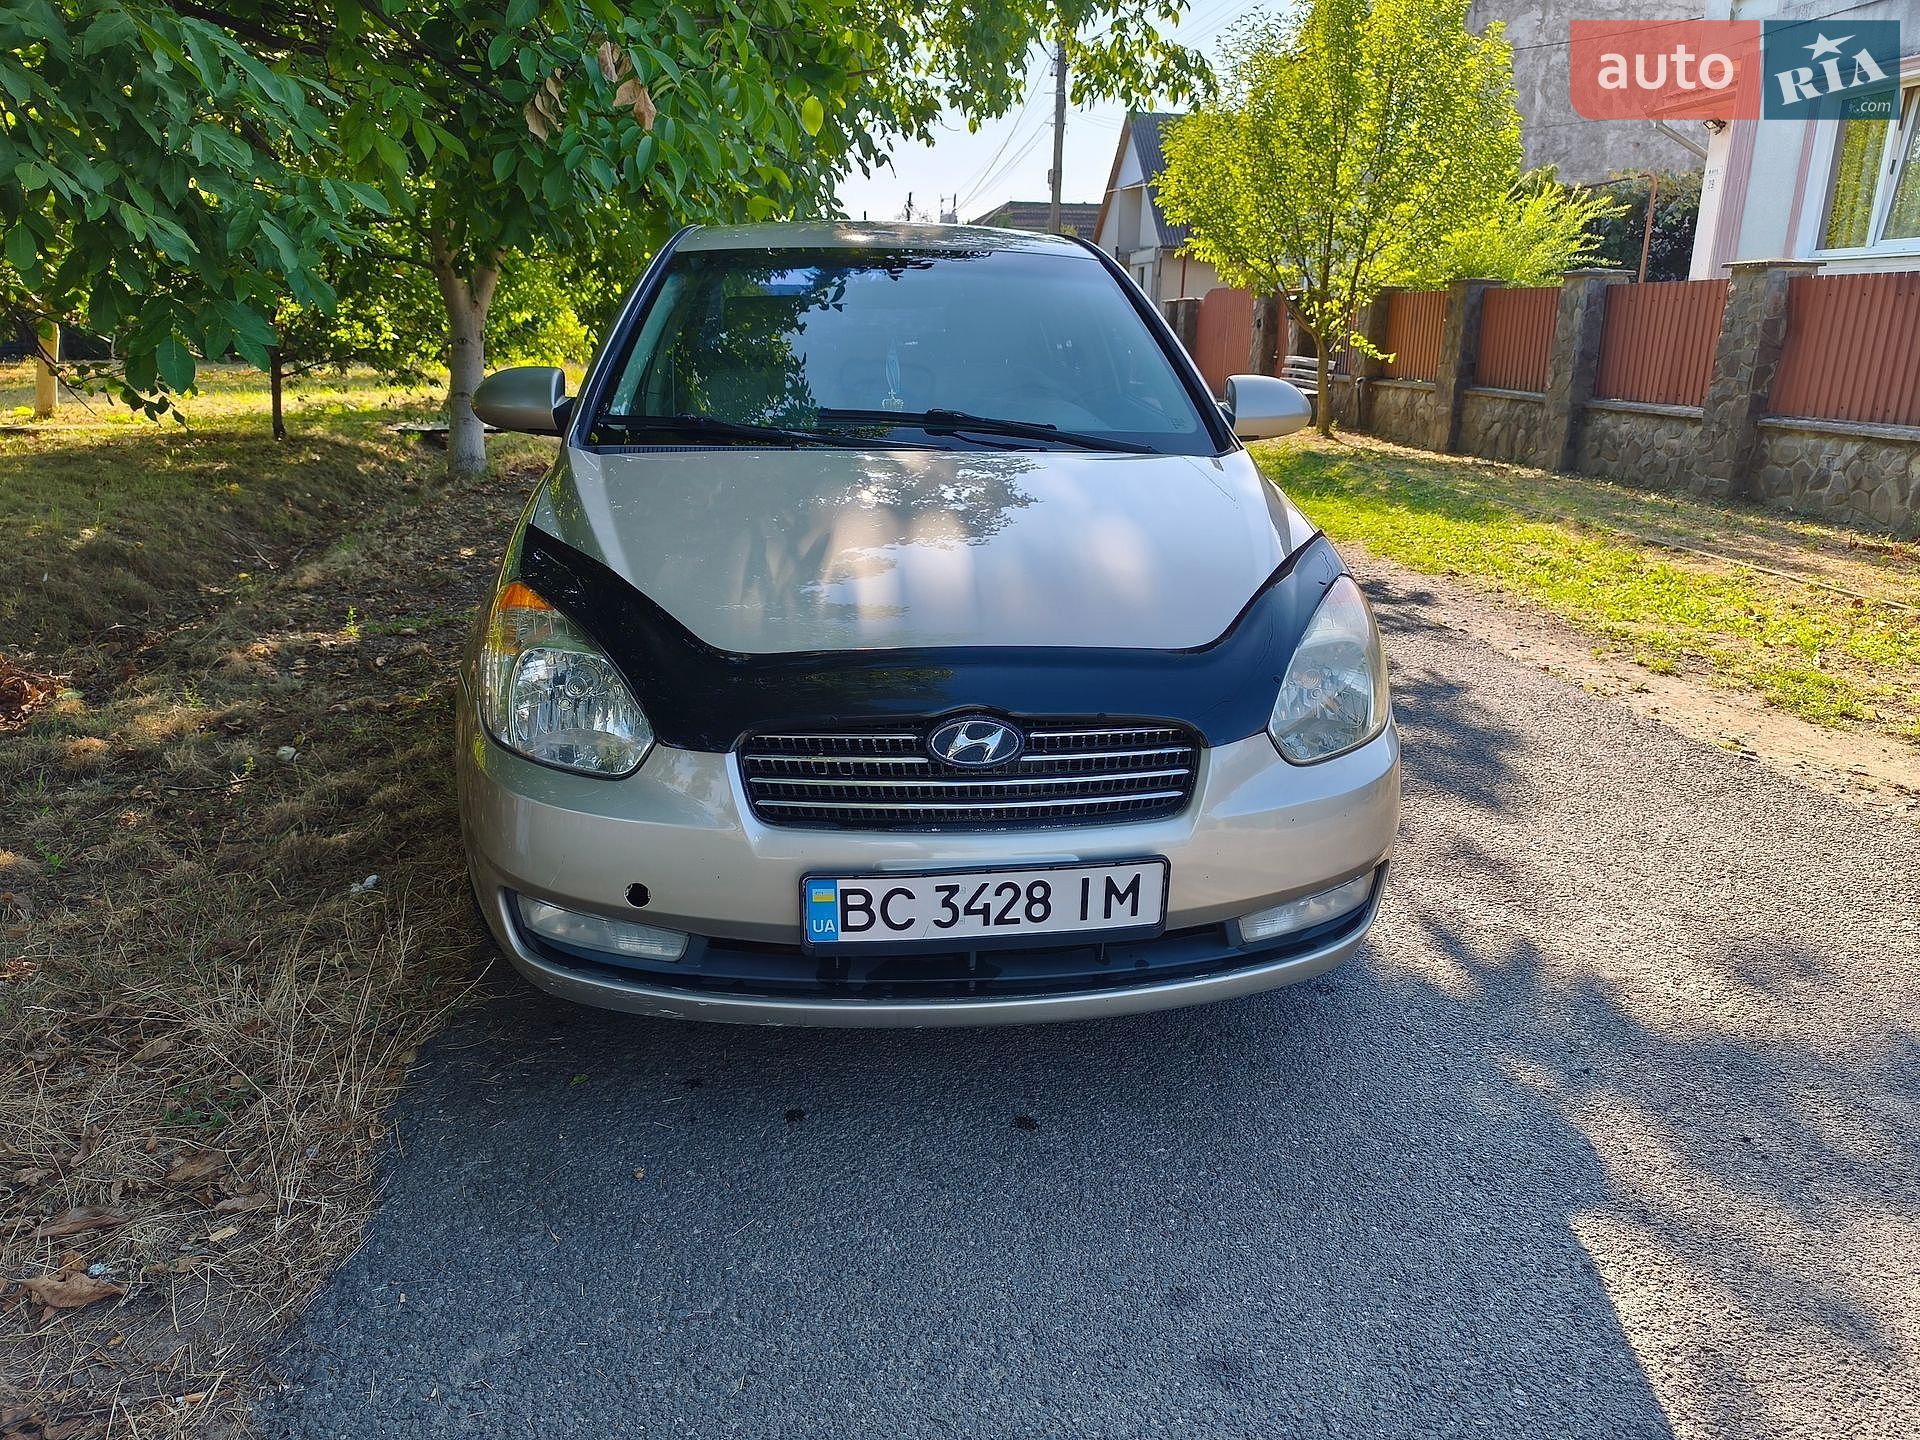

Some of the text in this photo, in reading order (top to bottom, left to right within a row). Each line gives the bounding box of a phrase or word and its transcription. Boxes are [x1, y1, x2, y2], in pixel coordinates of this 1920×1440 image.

[839, 873, 1142, 933] BC 3428 IM
[812, 918, 836, 933] UA
